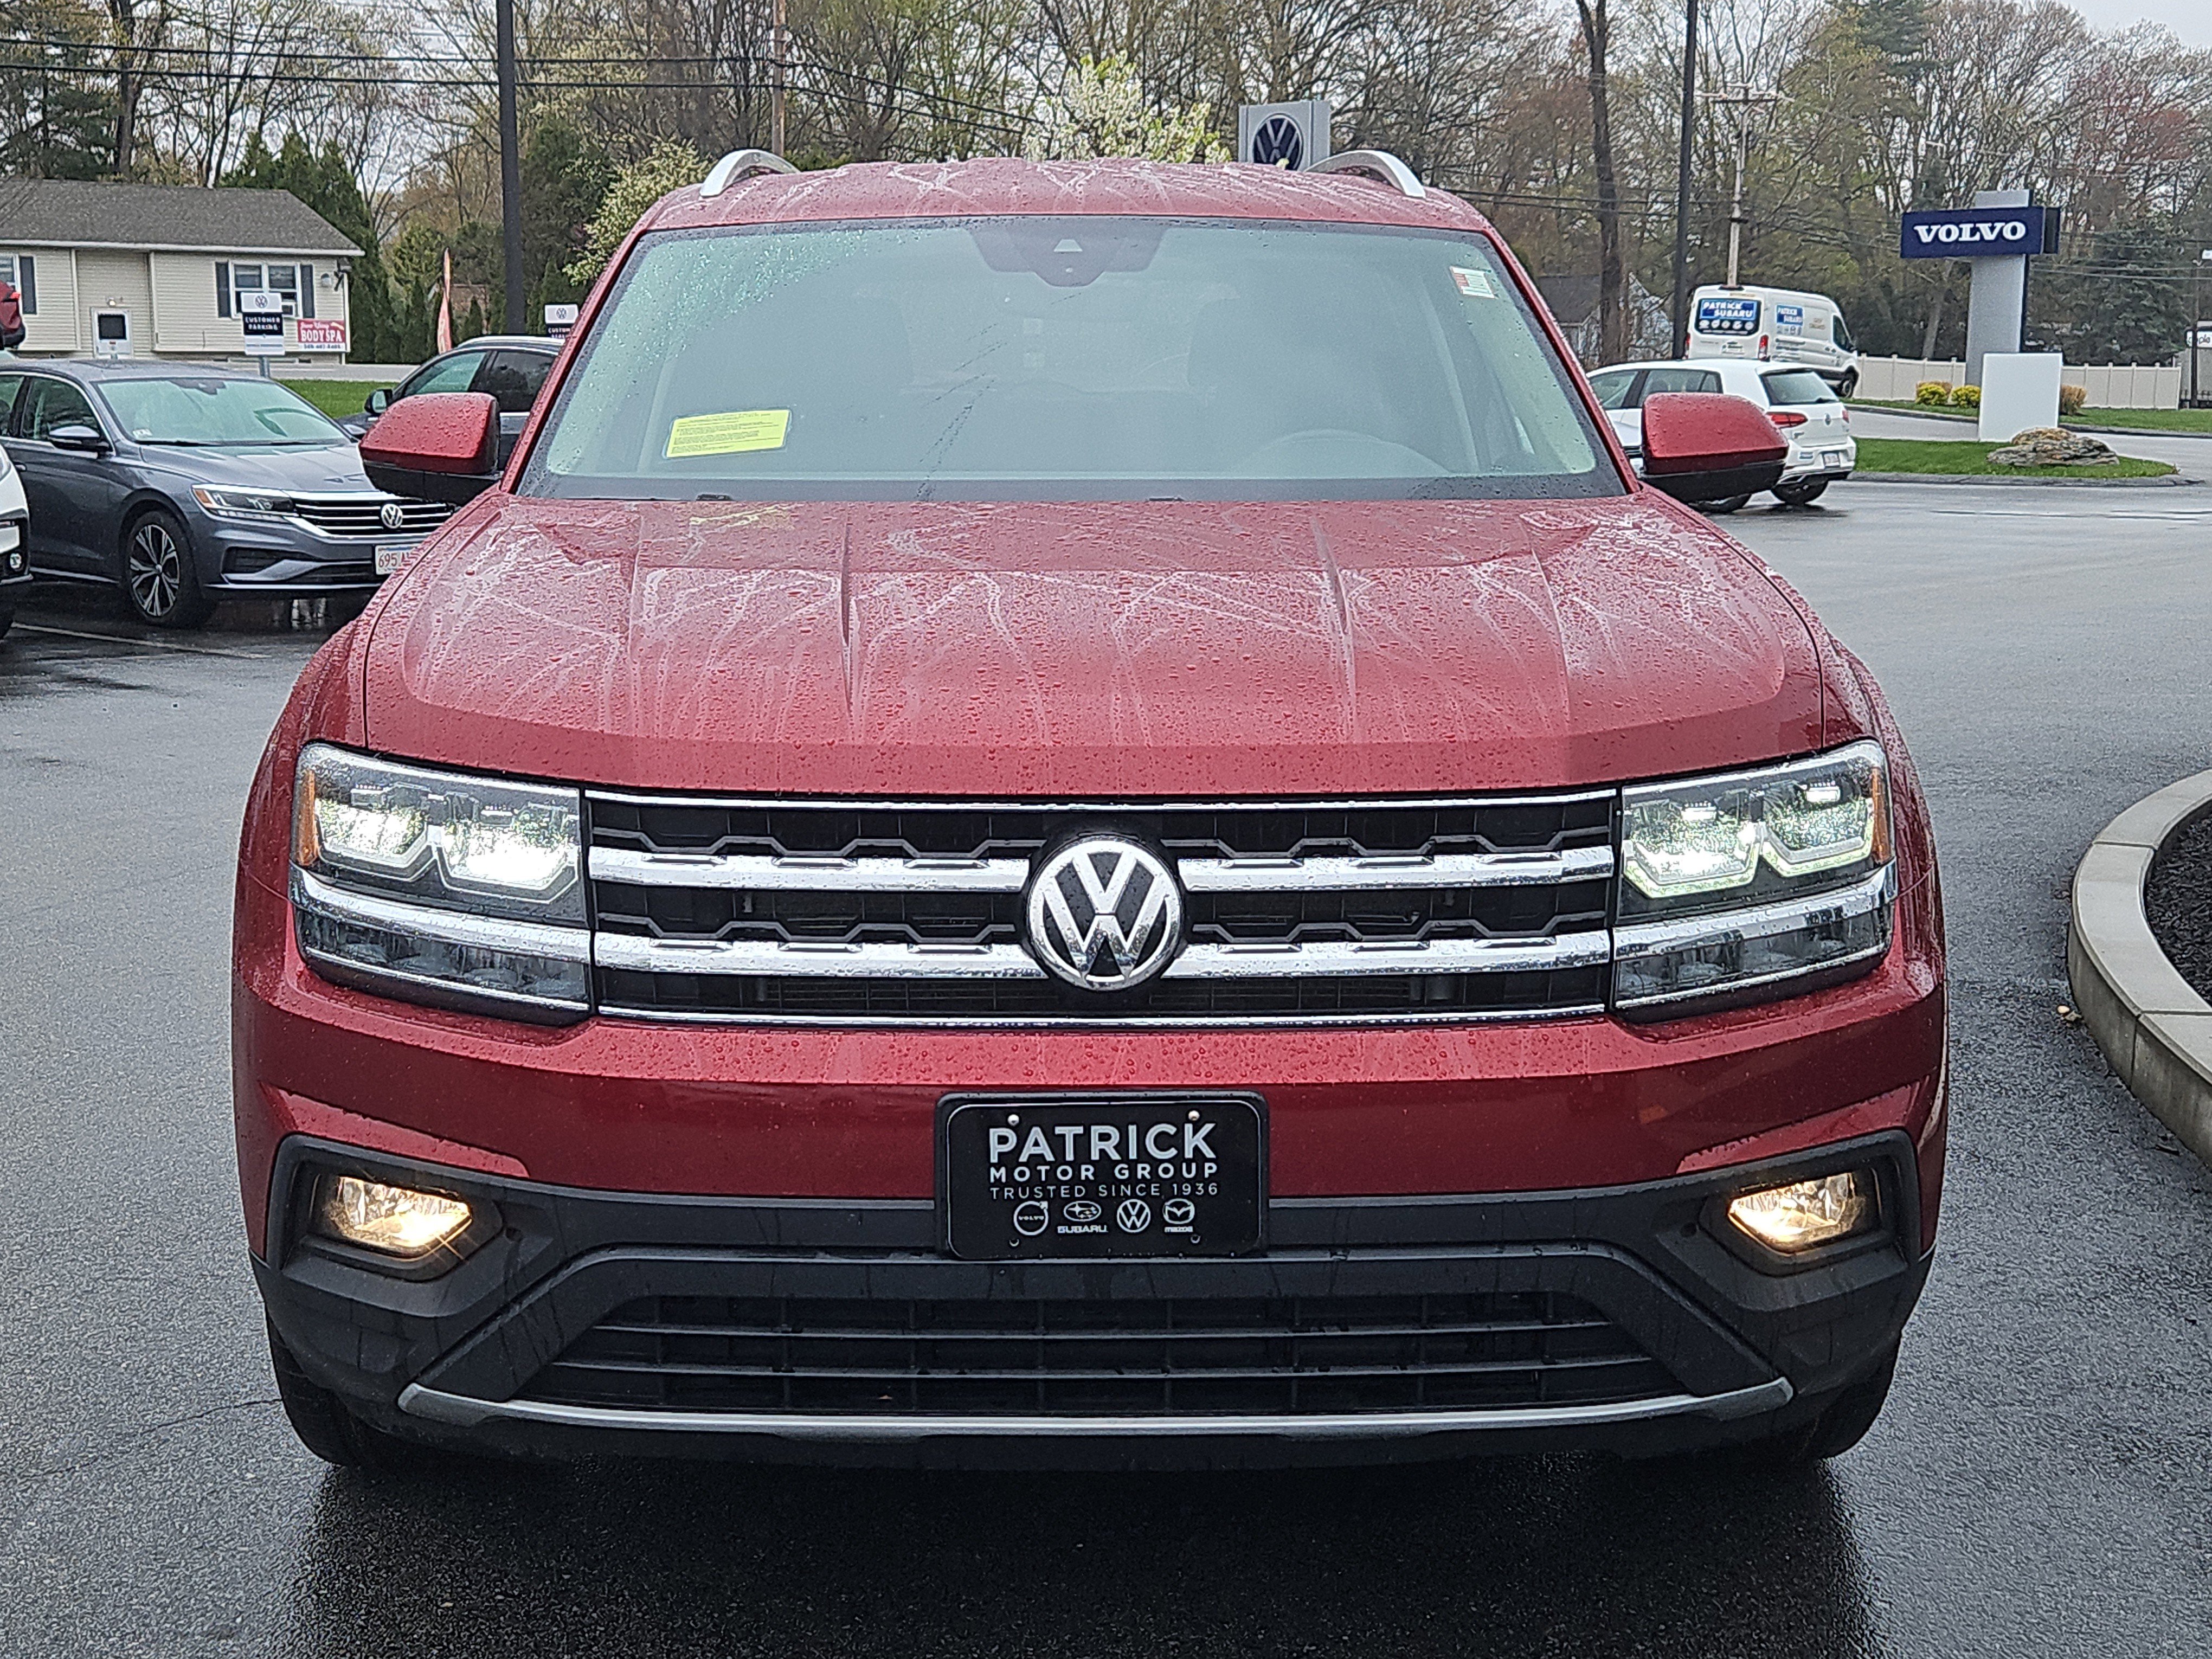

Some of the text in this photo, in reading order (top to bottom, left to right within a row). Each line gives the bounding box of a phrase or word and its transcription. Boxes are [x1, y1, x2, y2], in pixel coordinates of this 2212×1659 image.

[1914, 221, 2026, 242] VOLVO
[1702, 301, 1742, 310] PATRICK
[1714, 309, 1753, 318] SUBARU
[301, 329, 343, 342] BODY SPA
[378, 553, 397, 568] 695
[989, 1123, 1217, 1163] PATRICK
[990, 1162, 1217, 1183] MOTOR GROUP
[990, 1182, 1218, 1199] TRUSTED SINCE 1936
[1057, 1225, 1108, 1233] SUBARU
